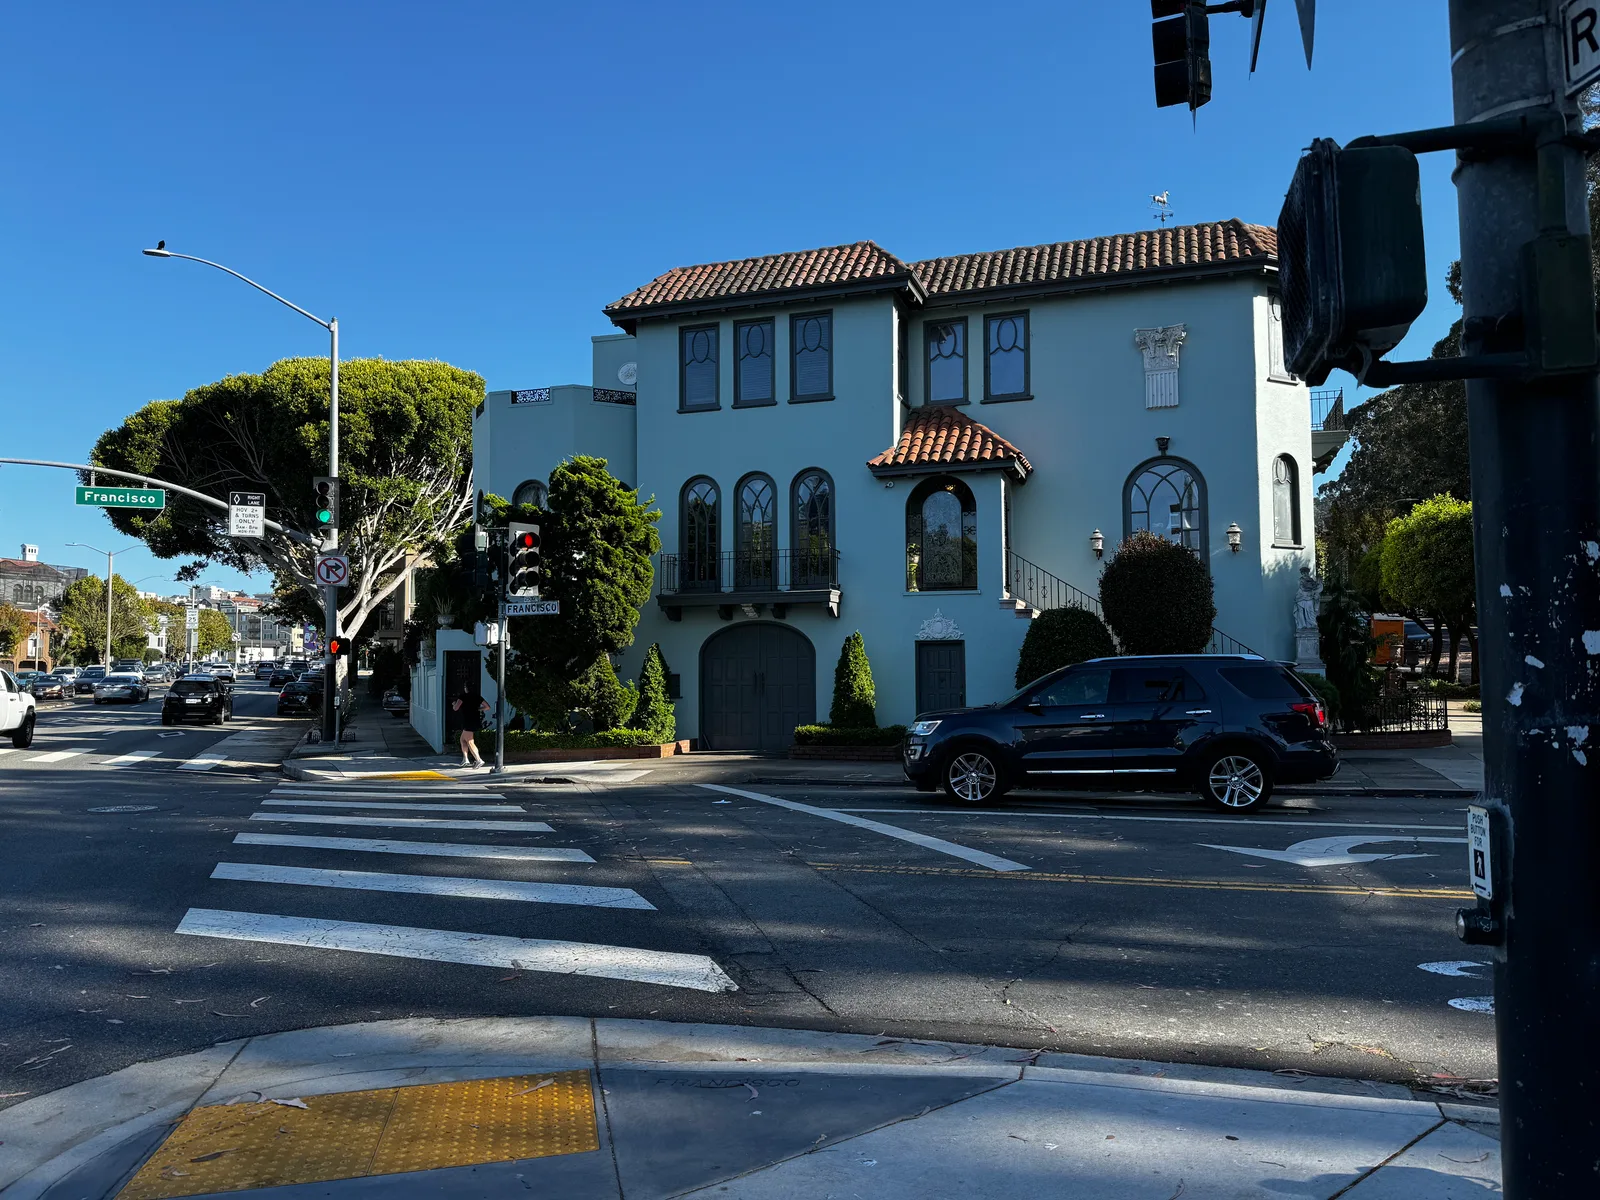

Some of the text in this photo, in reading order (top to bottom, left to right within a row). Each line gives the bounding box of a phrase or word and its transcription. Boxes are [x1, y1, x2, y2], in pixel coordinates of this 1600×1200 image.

[1571, 7, 1599, 66] R
[84, 491, 155, 503] Francisco
[507, 603, 557, 614] FRANCISCO
[1472, 813, 1484, 826] PUSH
[1470, 823, 1487, 838] BUTTON
[1474, 836, 1483, 848] FOR
